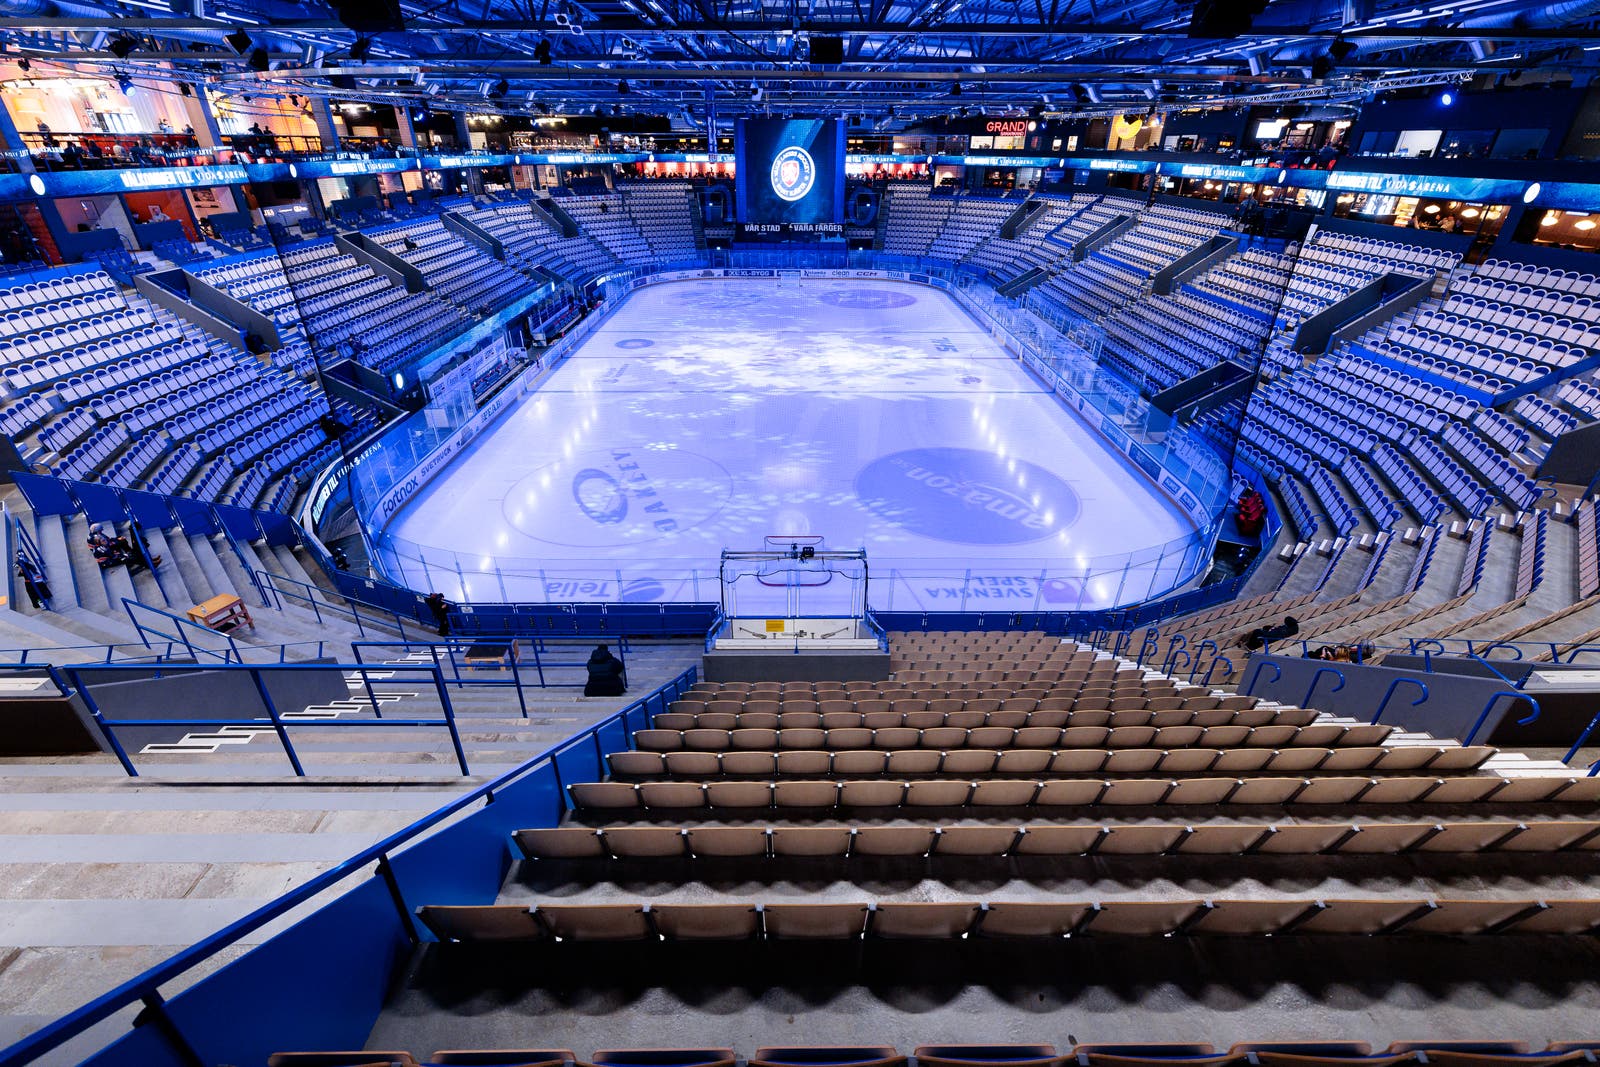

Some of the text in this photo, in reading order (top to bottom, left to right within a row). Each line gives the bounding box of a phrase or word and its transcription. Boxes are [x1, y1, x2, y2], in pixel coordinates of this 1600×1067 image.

[986, 121, 1026, 132] GRAND
[1416, 181, 1451, 194] ARENA
[760, 224, 781, 232] STAD
[360, 441, 382, 461] ARENA
[420, 444, 452, 477] SVETRUCK
[973, 575, 1030, 586] SPEL
[547, 581, 611, 598] Telia
[925, 587, 1034, 599] SVENSKA
